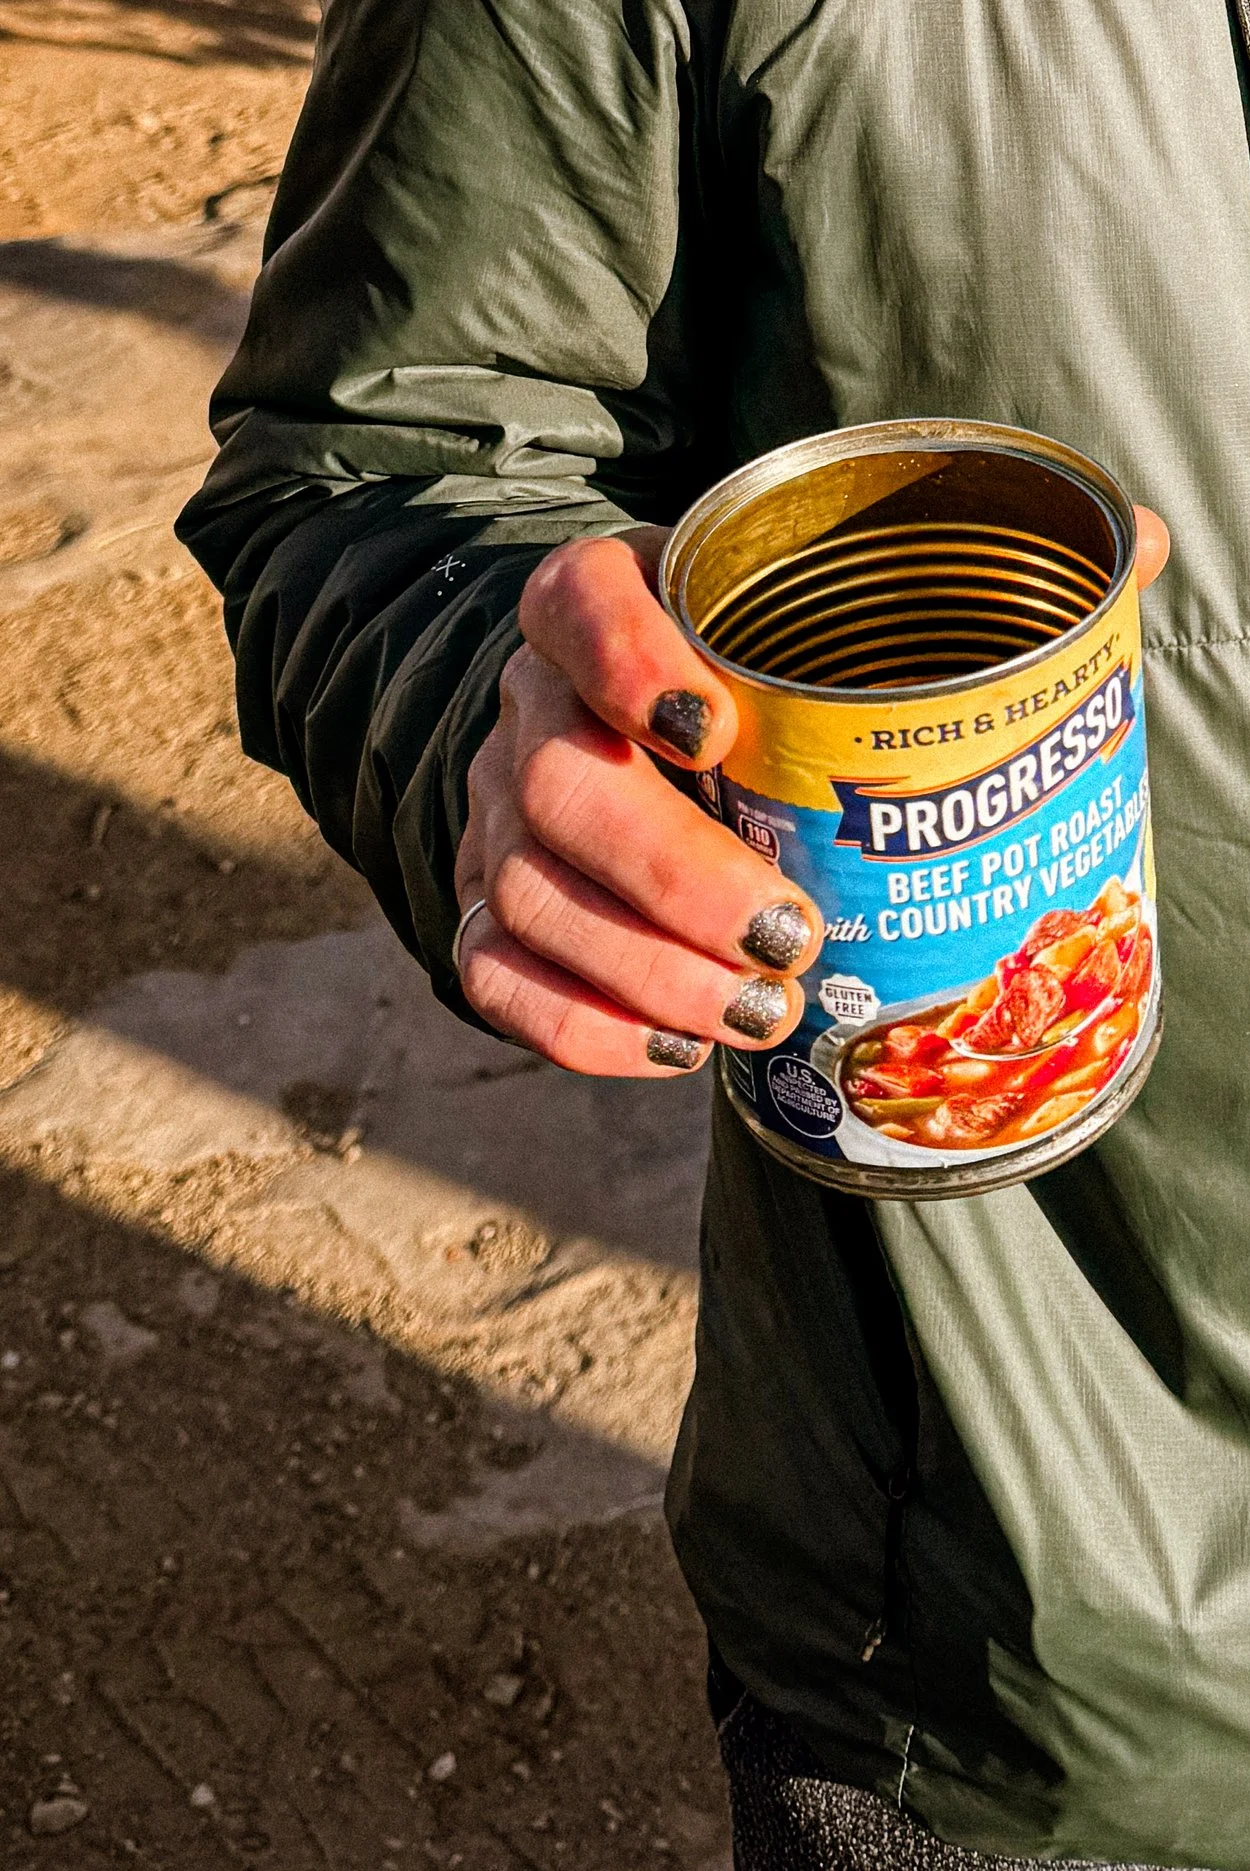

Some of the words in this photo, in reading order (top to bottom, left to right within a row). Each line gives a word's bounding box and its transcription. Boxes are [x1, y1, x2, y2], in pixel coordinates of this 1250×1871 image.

[871, 720, 964, 750] RICH
[973, 713, 995, 734] &
[1005, 639, 1115, 726] HEARTY
[869, 676, 1123, 852] PROGRESSO
[746, 822, 770, 846] 110
[887, 860, 970, 904] BEEF
[981, 833, 1041, 886] POT
[1051, 775, 1123, 857] ROAST
[877, 877, 1032, 942] COUNTRY
[825, 987, 872, 1003] GLUTEN
[835, 1001, 865, 1015] FREE
[785, 1062, 816, 1086] U.S.
